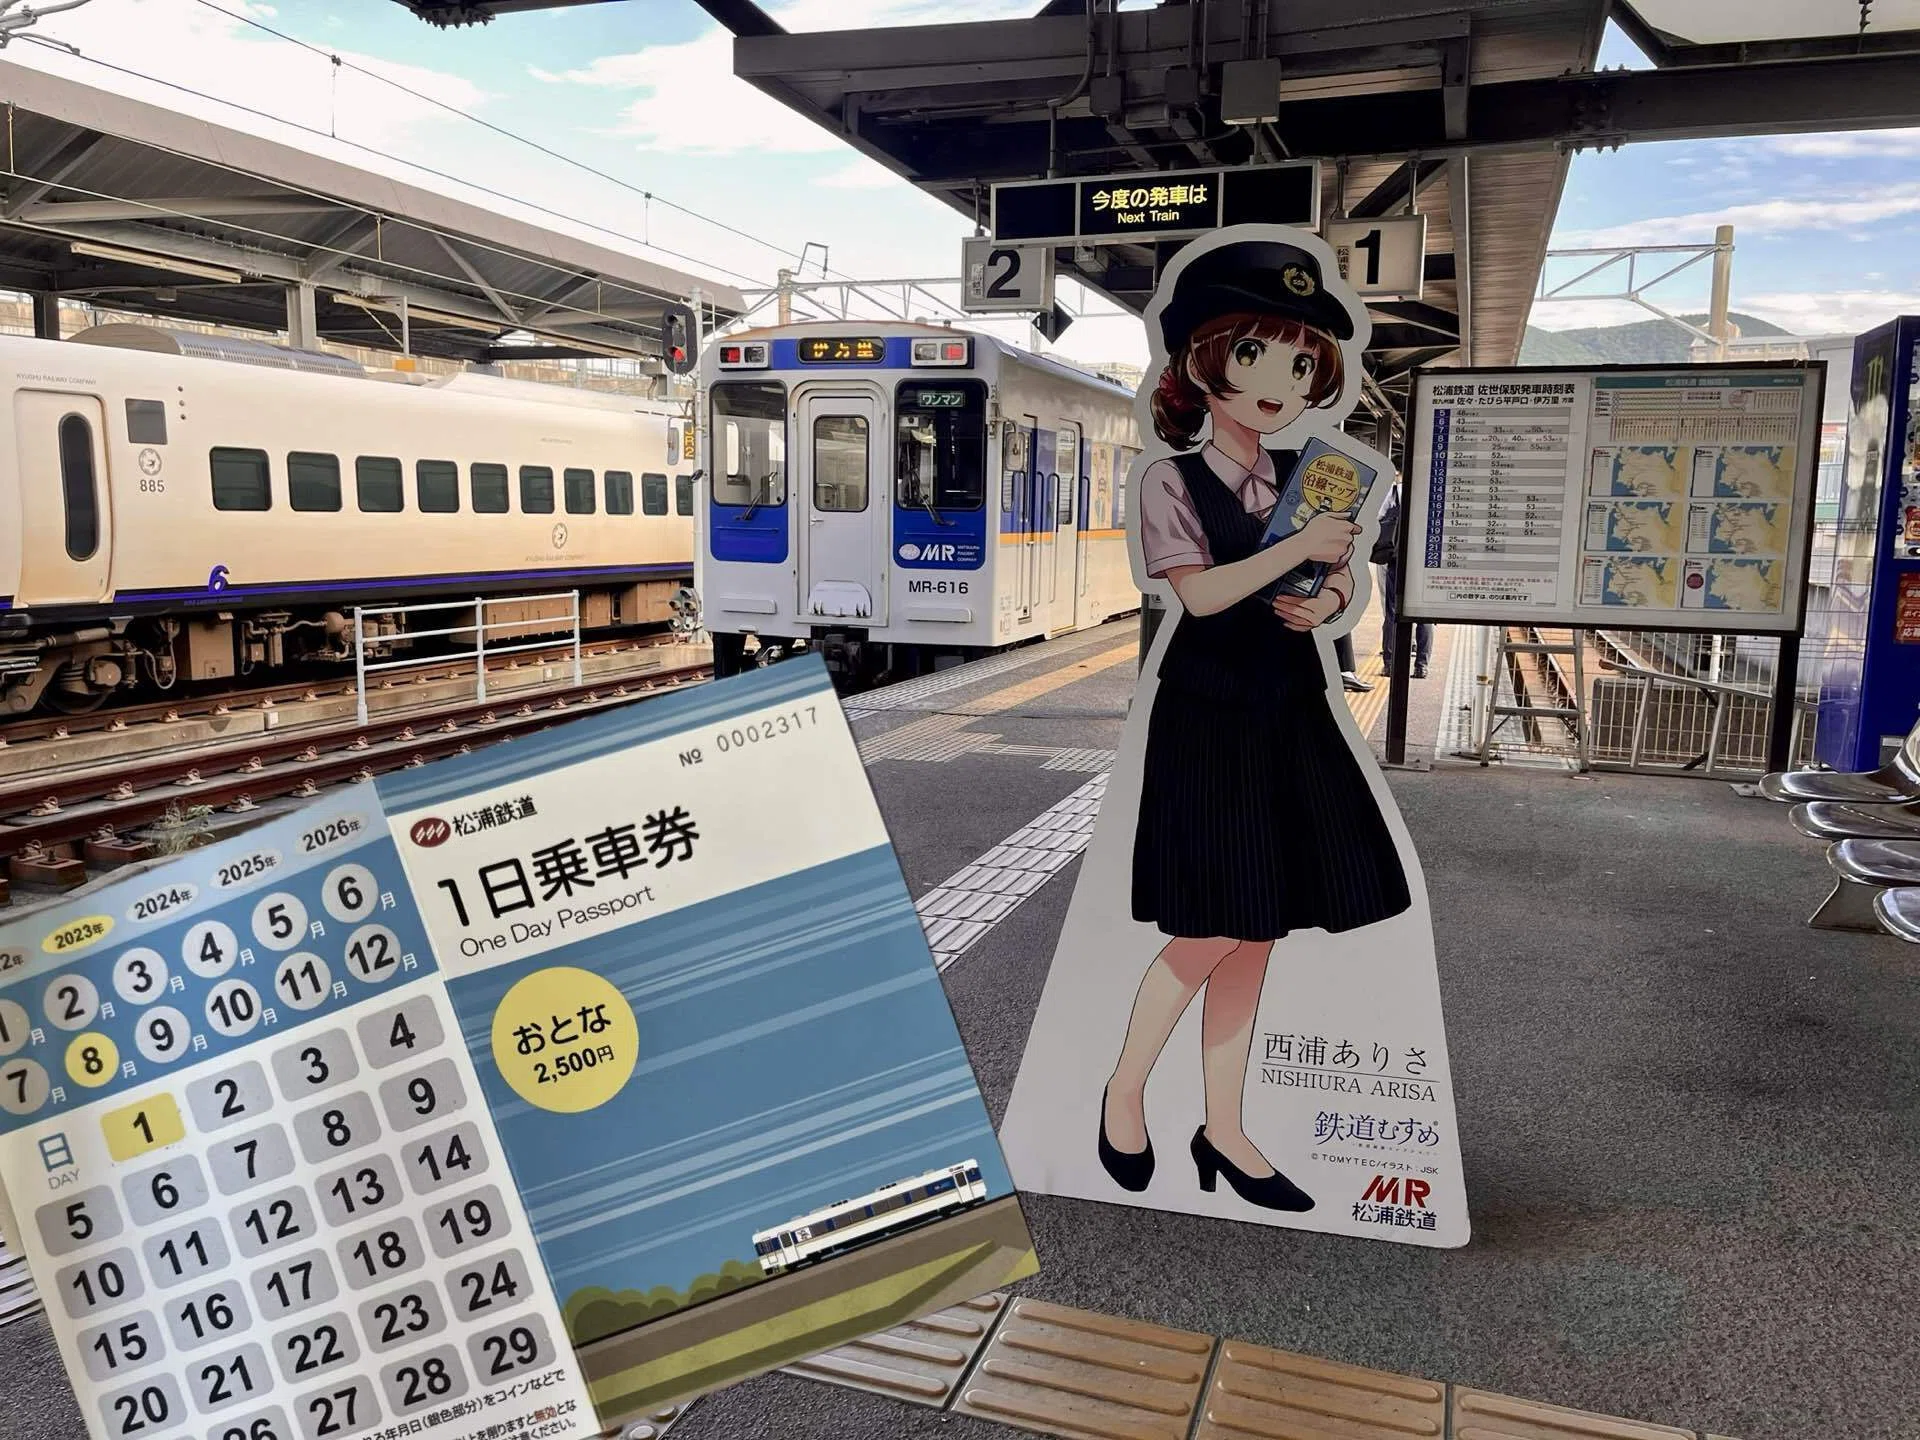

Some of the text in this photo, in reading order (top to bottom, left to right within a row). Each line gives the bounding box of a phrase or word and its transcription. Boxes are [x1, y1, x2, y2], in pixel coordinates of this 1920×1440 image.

[1092, 184, 1207, 211] 今度の発車は
[1117, 209, 1179, 224] Next Train
[987, 249, 1020, 298] 2
[1355, 229, 1381, 284] 1
[922, 394, 961, 406] ワンマン
[1433, 385, 1474, 396] 松浦鉄道
[139, 479, 165, 493] 885
[1304, 472, 1357, 498] 沿線マップ
[920, 544, 955, 561] MR
[208, 565, 230, 594] 6
[908, 580, 969, 594] MR-616
[716, 706, 818, 753] 0002317
[452, 795, 538, 838] 松浦鉄道
[437, 805, 700, 927] 1日乗車券
[0, 819, 361, 972] 2年 2023年 2024年 2025年 2026年
[459, 885, 655, 958] One Day Passport
[512, 1003, 612, 1055] おとな
[533, 1045, 615, 1083] 2,500円
[1263, 1033, 1427, 1075] 西浦ありさ
[134, 1013, 416, 1143] 1 2 3 4
[1261, 1068, 1437, 1103] NISHIURA ARISA
[38, 1132, 75, 1173] 日
[66, 1077, 436, 1240] 5 6 7 8 9
[47, 1168, 81, 1190] DAY
[1361, 1175, 1431, 1208] MR
[72, 1134, 472, 1306] 10 11 12 13 14
[1352, 1202, 1437, 1231] 松浦鉄道
[94, 1199, 492, 1368] 15 16 17 18 19
[115, 1260, 518, 1435] 20 21 22 23 24
[309, 1386, 358, 1437] 27
[396, 1357, 452, 1407] 28
[484, 1327, 538, 1376] 29
